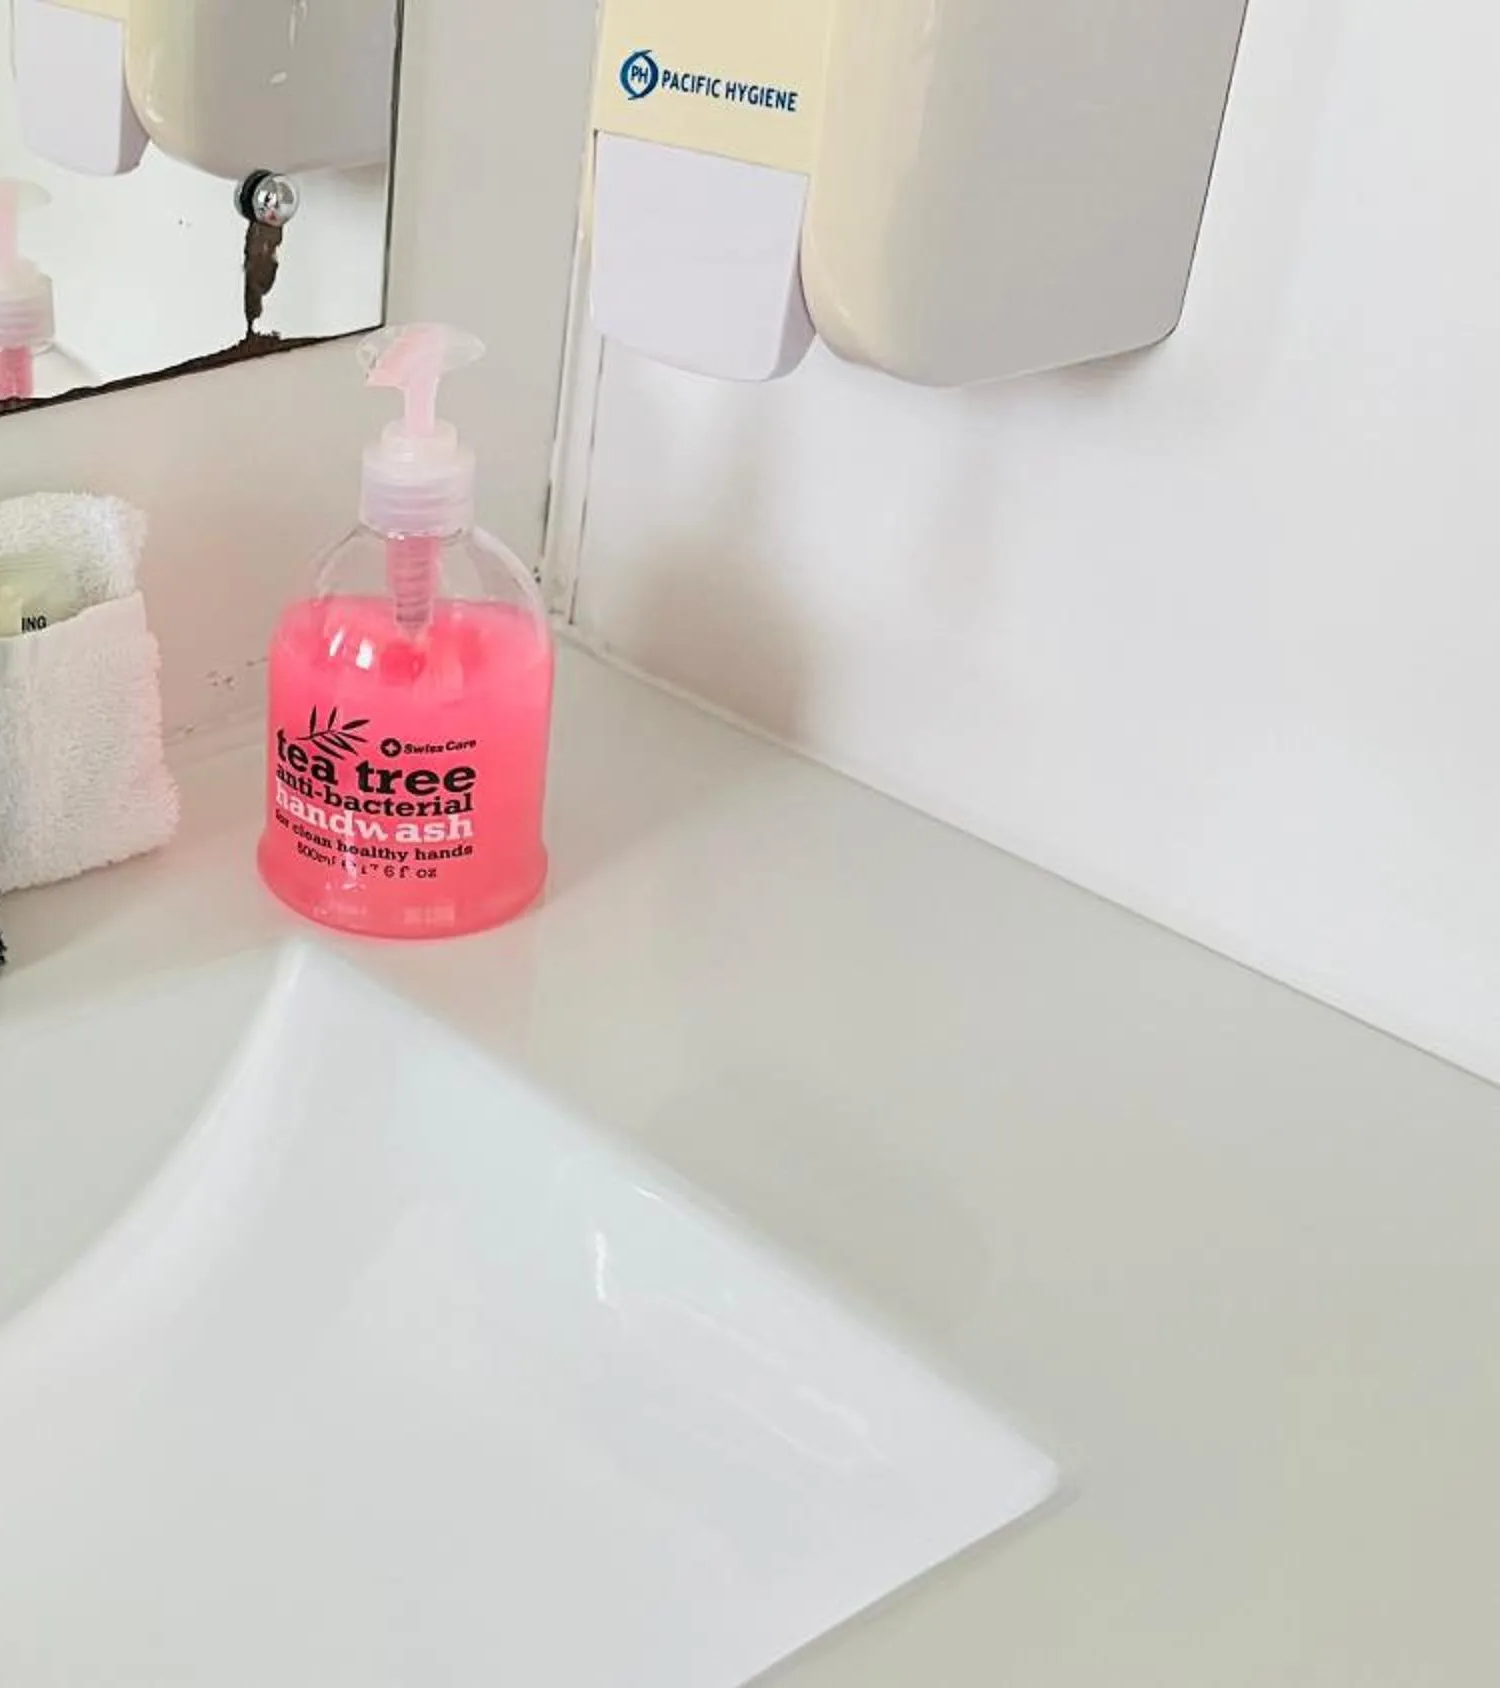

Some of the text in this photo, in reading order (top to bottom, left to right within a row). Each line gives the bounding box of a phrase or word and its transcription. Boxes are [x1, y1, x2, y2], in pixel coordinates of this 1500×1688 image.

[630, 65, 649, 84] PH
[661, 69, 799, 112] PACIFIC HYGIENE
[276, 728, 477, 796] tea tree
[403, 738, 477, 755] Swiss Care
[276, 763, 475, 817] anti-bacterial
[292, 824, 333, 849] clean
[337, 839, 409, 863] healthy
[414, 844, 473, 860] hands
[415, 866, 437, 879] oz
